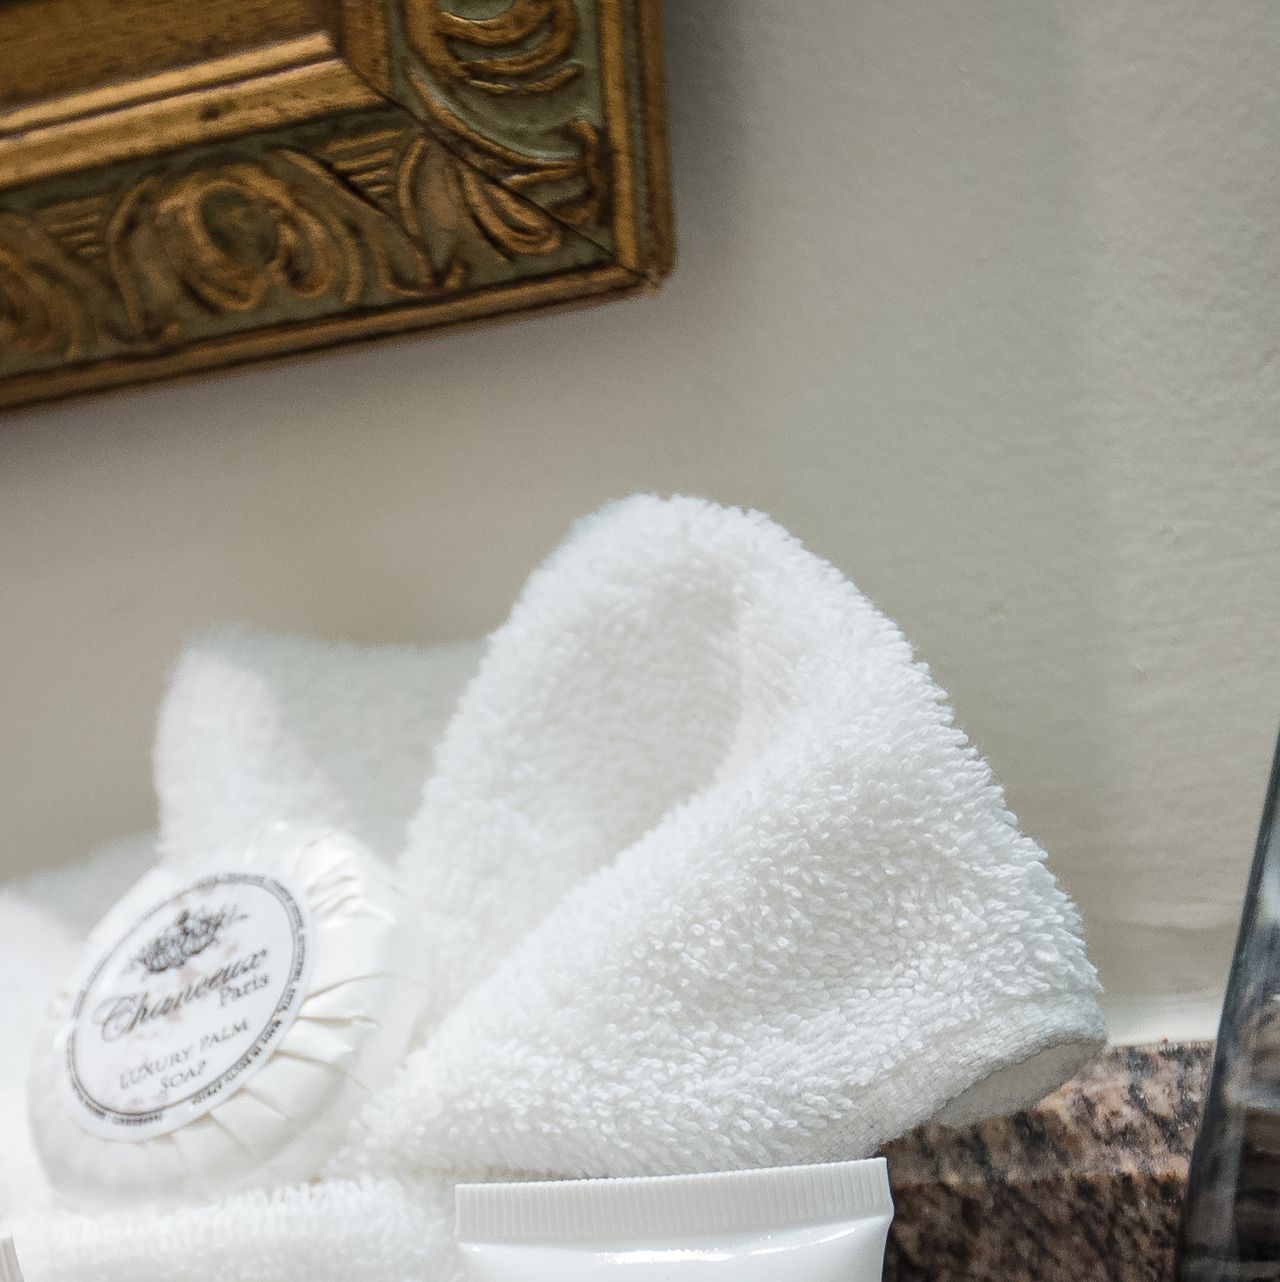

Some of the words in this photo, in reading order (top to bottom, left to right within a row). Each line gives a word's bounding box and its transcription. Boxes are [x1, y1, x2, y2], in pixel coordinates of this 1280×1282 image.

[220, 974, 271, 1007] Paris
[120, 1038, 192, 1089] LUXURY
[200, 1018, 248, 1057] PALM
[160, 1060, 207, 1091] SOAP
